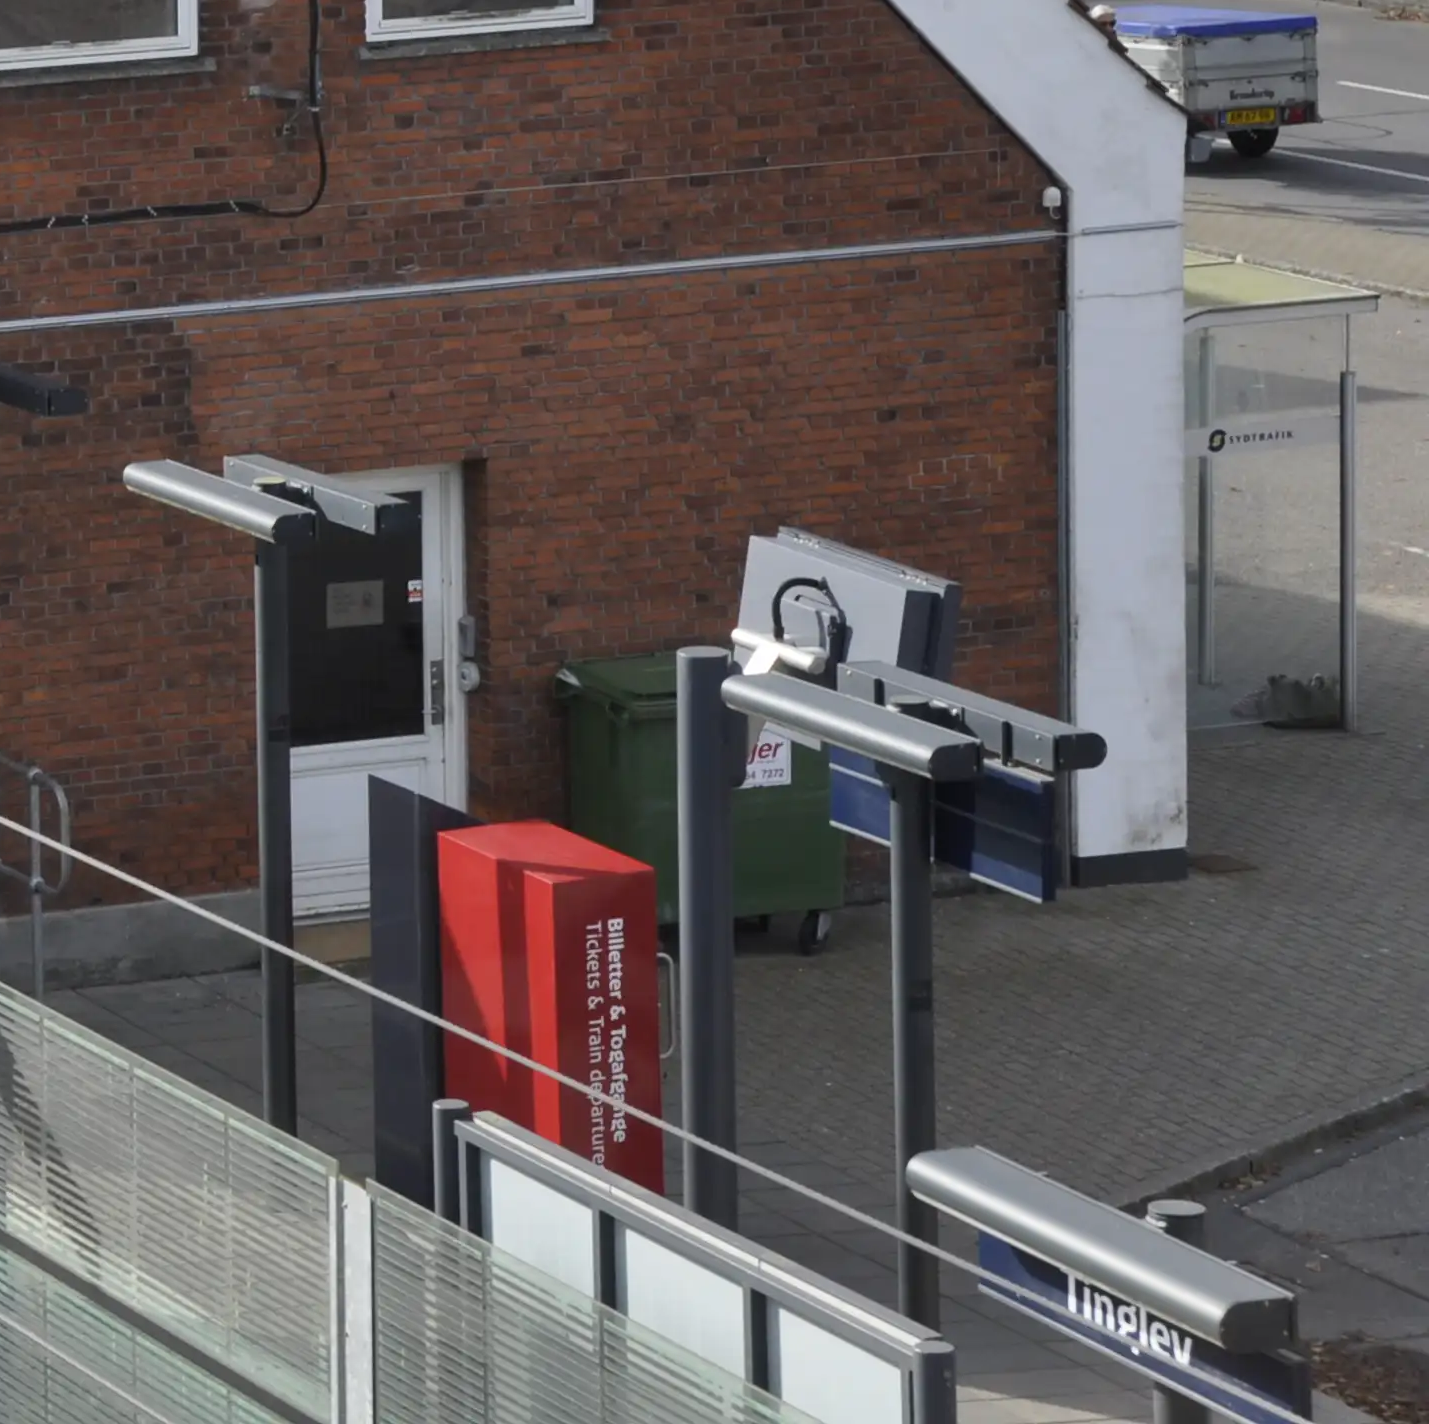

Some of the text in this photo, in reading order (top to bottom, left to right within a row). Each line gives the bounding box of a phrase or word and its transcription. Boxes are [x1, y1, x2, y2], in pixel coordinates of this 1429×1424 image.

[746, 741, 785, 765] jer
[607, 917, 625, 1000] Billetter
[585, 920, 606, 1170] Tickets & Train departure
[609, 1004, 626, 1022] &
[1062, 1268, 1193, 1366] Tinglev
